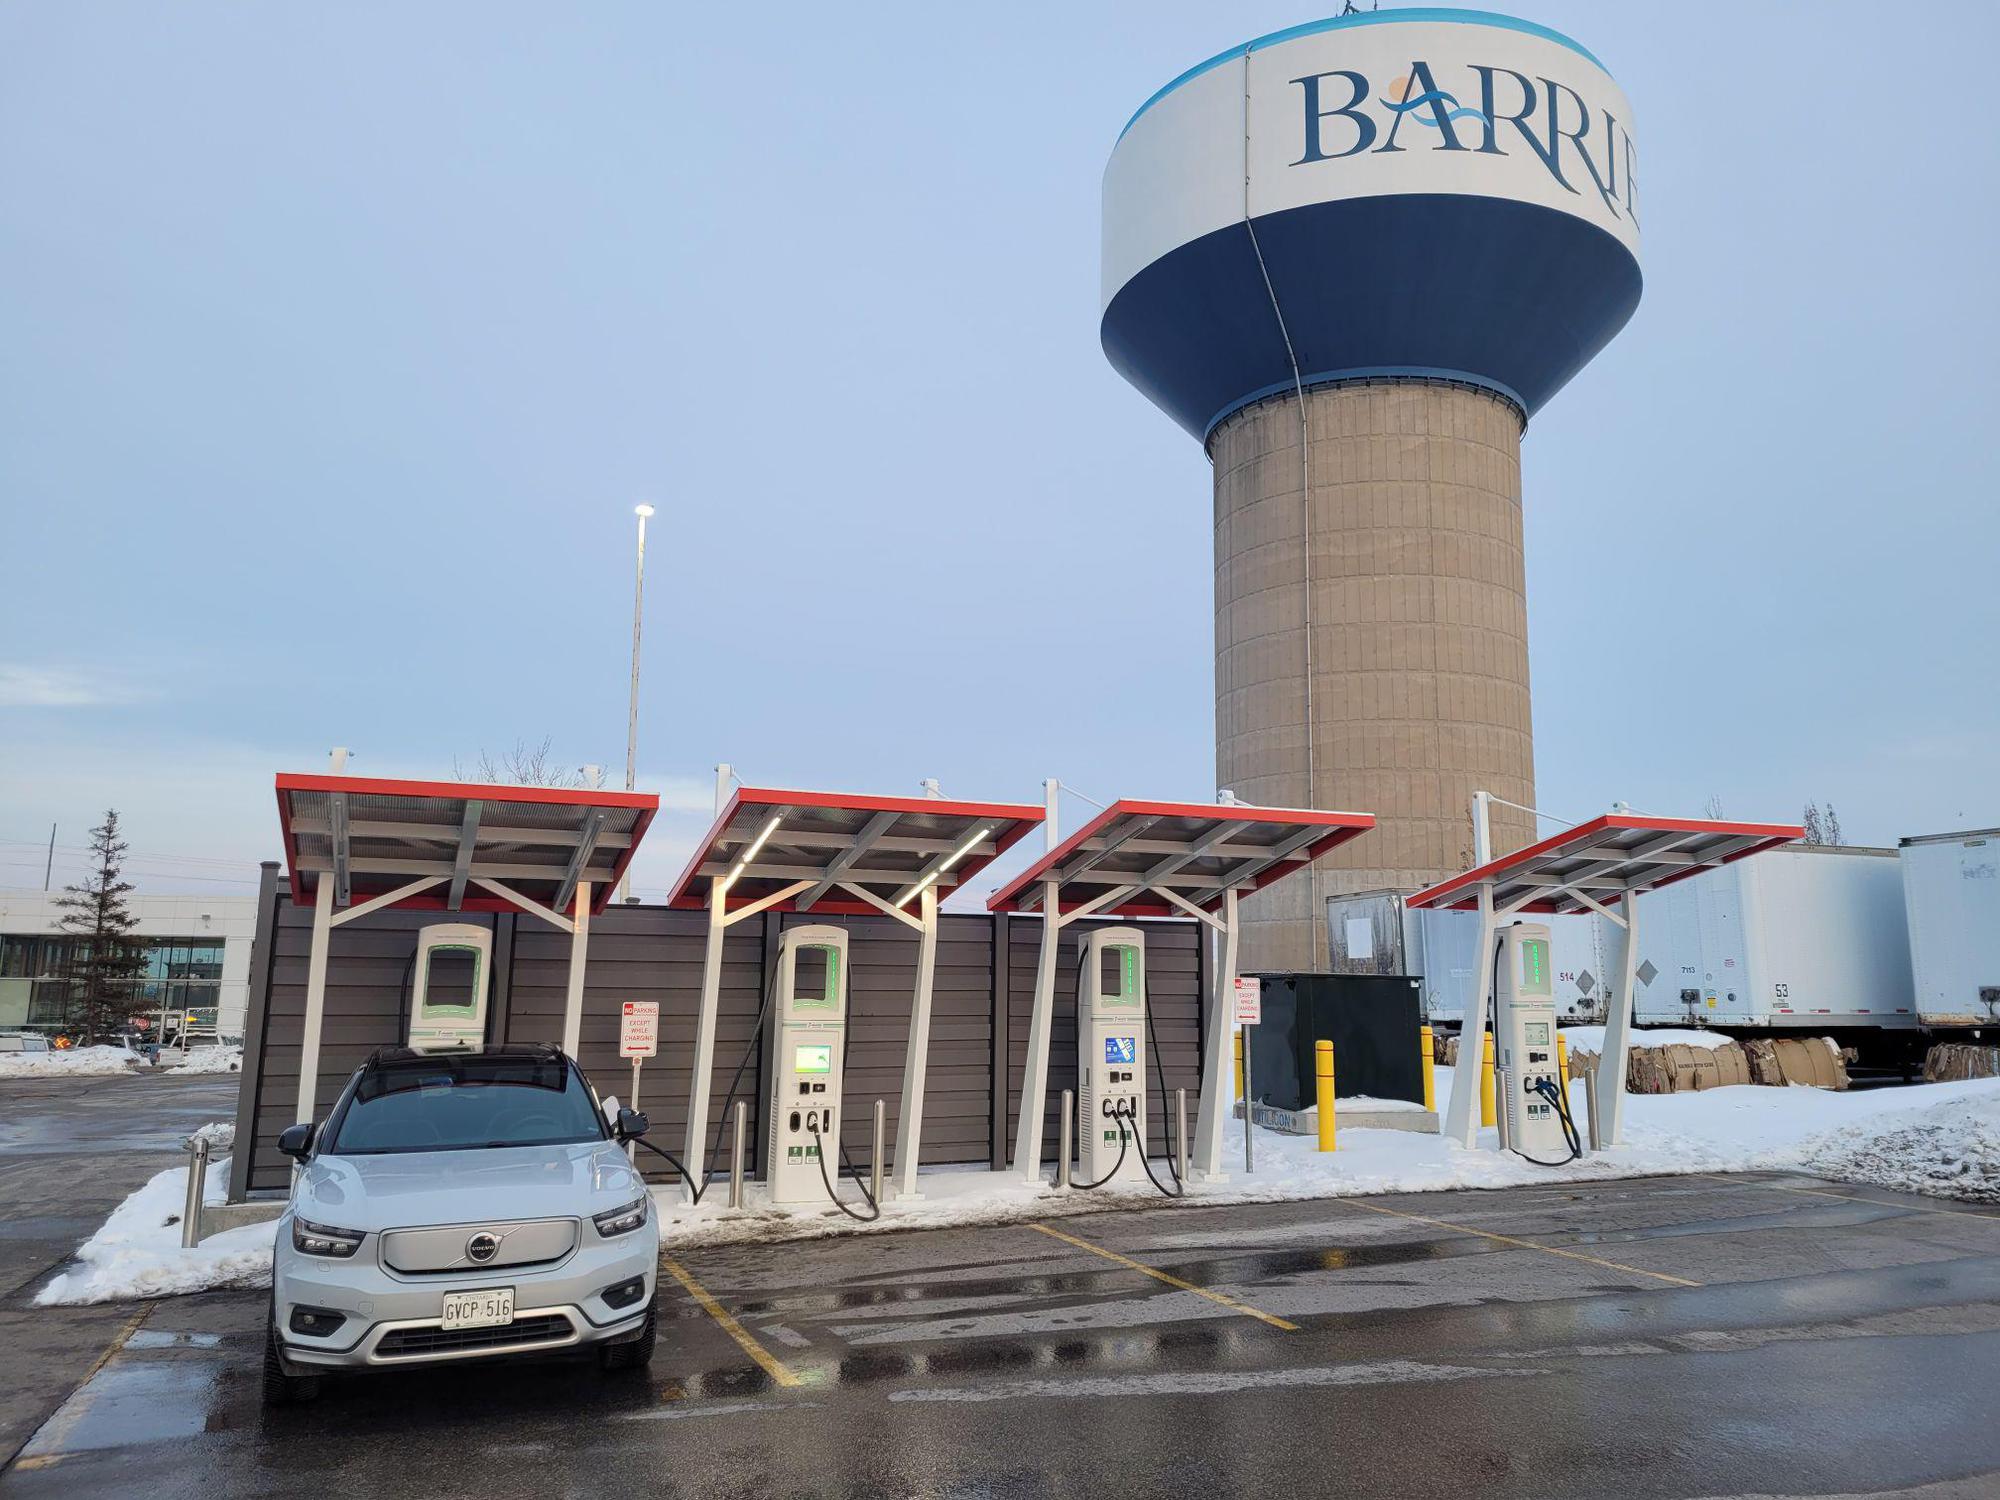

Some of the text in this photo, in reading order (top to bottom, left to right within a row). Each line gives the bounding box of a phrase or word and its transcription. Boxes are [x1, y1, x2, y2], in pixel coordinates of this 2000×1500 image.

[1560, 972, 1574, 982] 514
[1775, 983, 1789, 998] 53
[446, 1299, 510, 1321] GVCP 516
